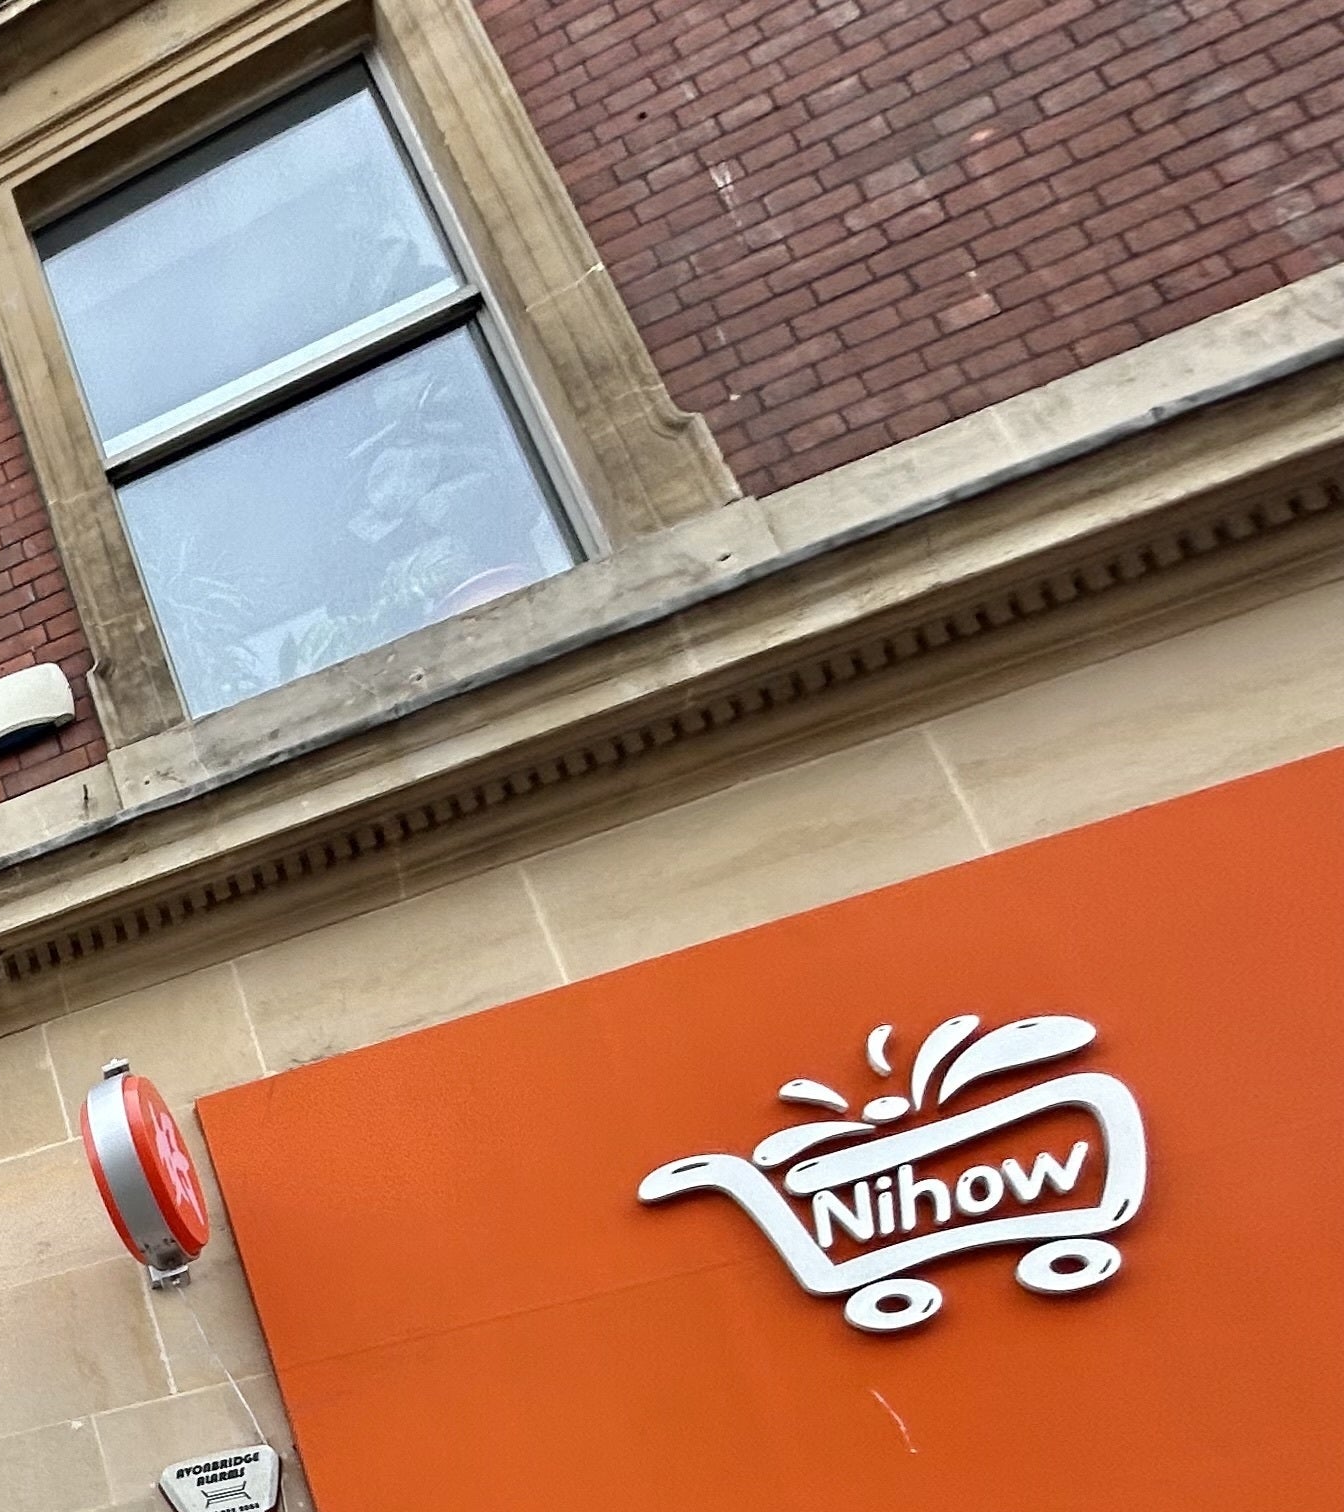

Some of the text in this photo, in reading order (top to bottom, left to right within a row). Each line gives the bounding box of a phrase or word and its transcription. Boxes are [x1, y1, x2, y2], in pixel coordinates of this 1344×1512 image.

[812, 1142, 1088, 1249] Nihow
[176, 1452, 259, 1479] AVONBRIDGE
[197, 1467, 245, 1486] ALARMS
